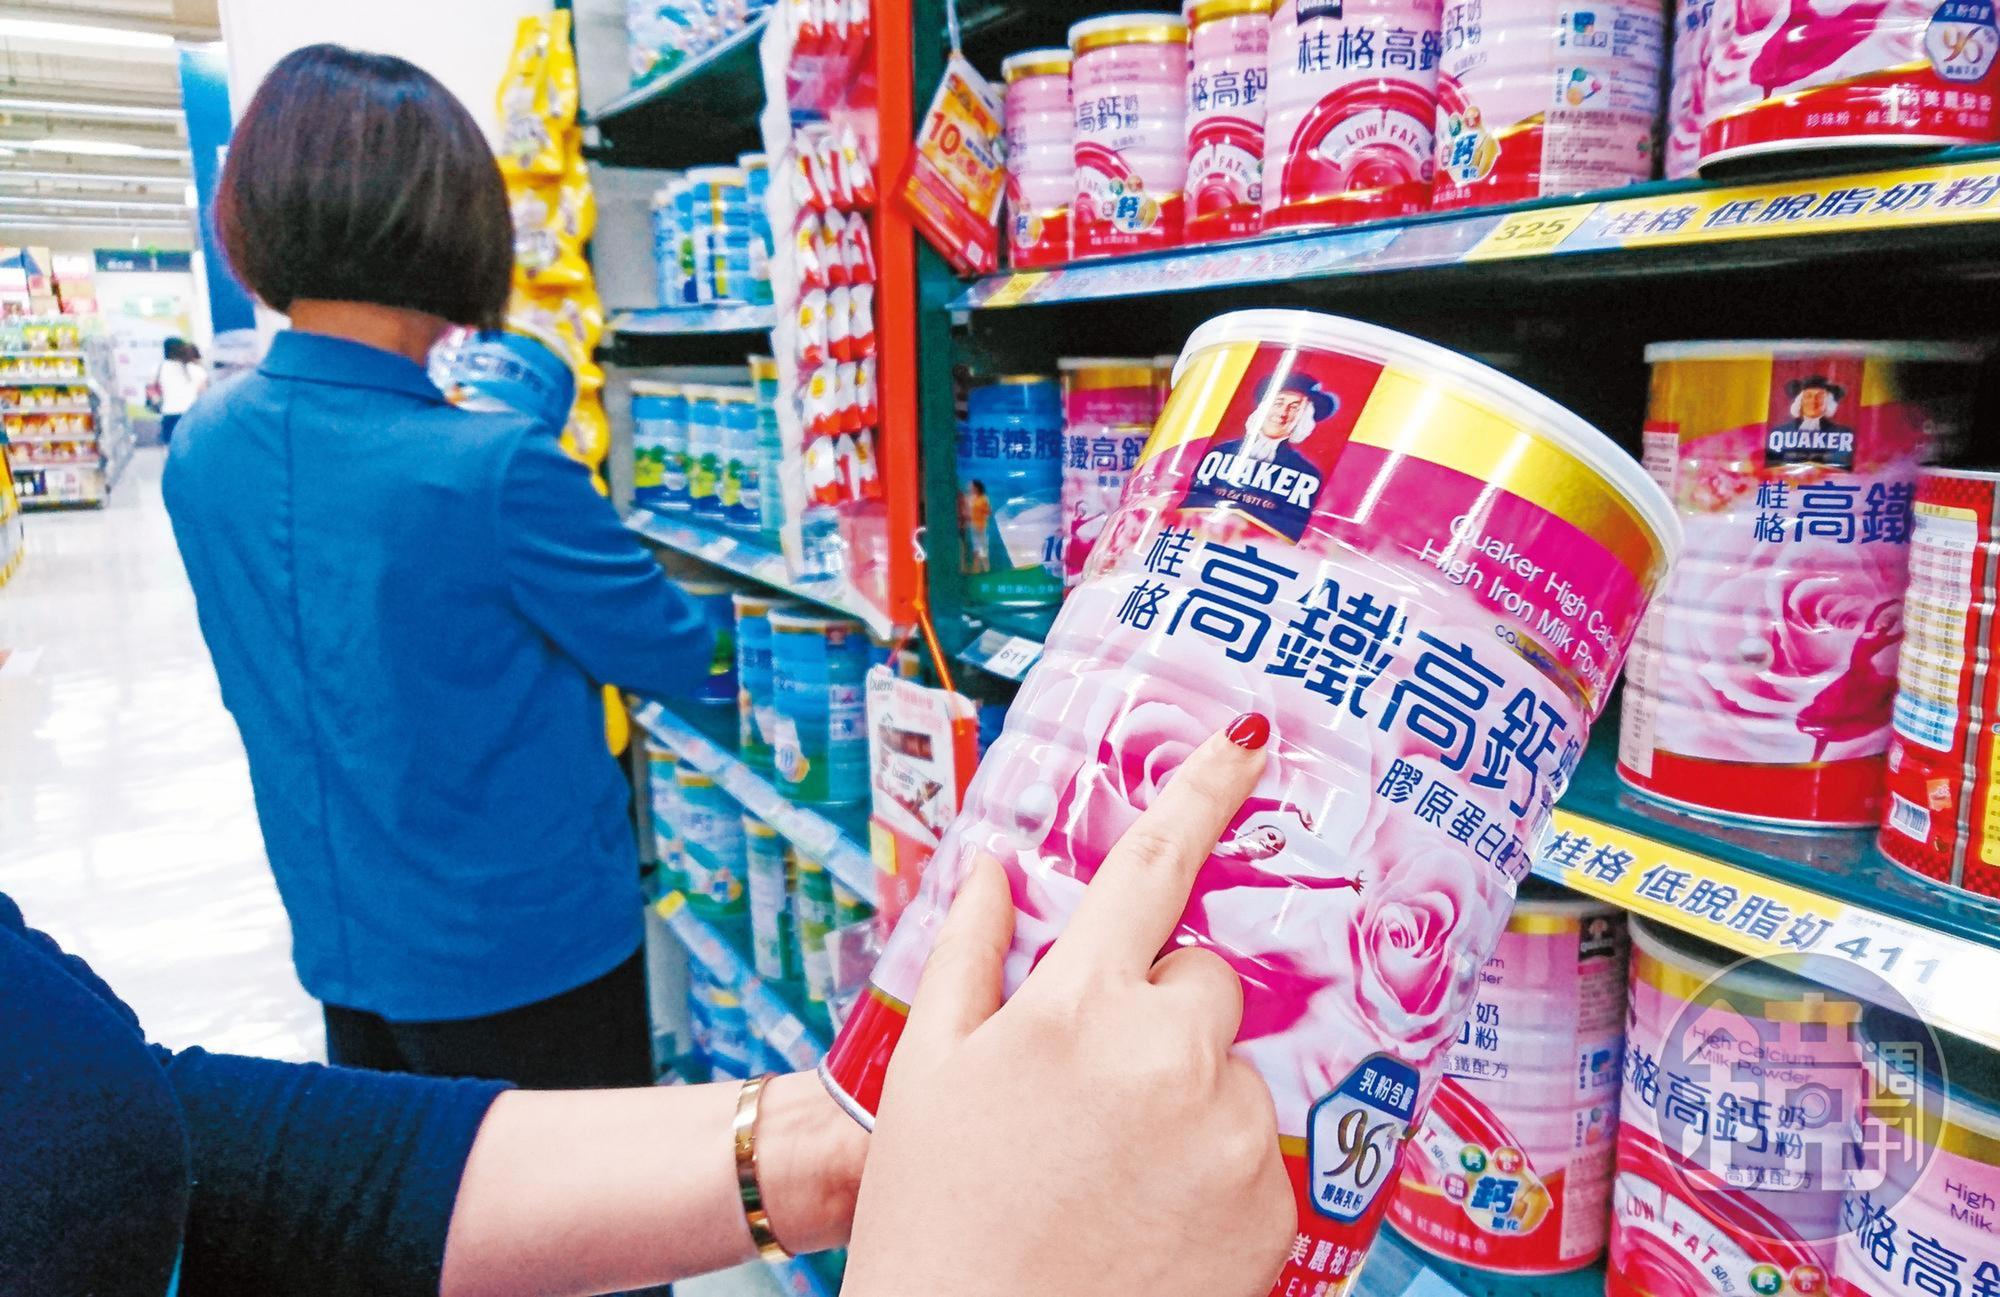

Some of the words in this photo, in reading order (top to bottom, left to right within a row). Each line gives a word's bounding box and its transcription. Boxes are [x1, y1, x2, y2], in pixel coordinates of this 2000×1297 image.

[1943, 26, 1983, 63] 96
[1345, 123, 1378, 145] LOW
[1390, 125, 1417, 146] FAT
[1218, 157, 1242, 172] FAT
[1495, 218, 1571, 240] 325
[1769, 430, 1853, 453] QUAKER
[1197, 451, 1320, 509] QUAKER
[1450, 515, 1544, 583] Quaker
[1544, 572, 1588, 622] High
[1420, 539, 1484, 590] High
[1488, 576, 1533, 622] Iron
[1536, 609, 1576, 653] Milk
[1000, 648, 1028, 664] 611
[1544, 831, 1634, 885] 桂格
[1835, 936, 1940, 984] 411
[1475, 1002, 1499, 1051] 奶粉
[1693, 1026, 1731, 1051] High
[1737, 1040, 1816, 1066] Calcium
[1697, 1046, 1729, 1069] Milk
[1737, 1060, 1813, 1084] Powder
[1359, 1068, 1415, 1112] 乳粉含量
[1323, 1109, 1395, 1188] 96
[1775, 1103, 1806, 1159] 奶粉
[1471, 1176, 1520, 1214] 鈣
[1945, 1178, 1996, 1212] High
[1626, 1194, 1655, 1222] LOW
[1671, 1220, 1719, 1263] FAT
[1950, 1203, 1993, 1233] Milk
